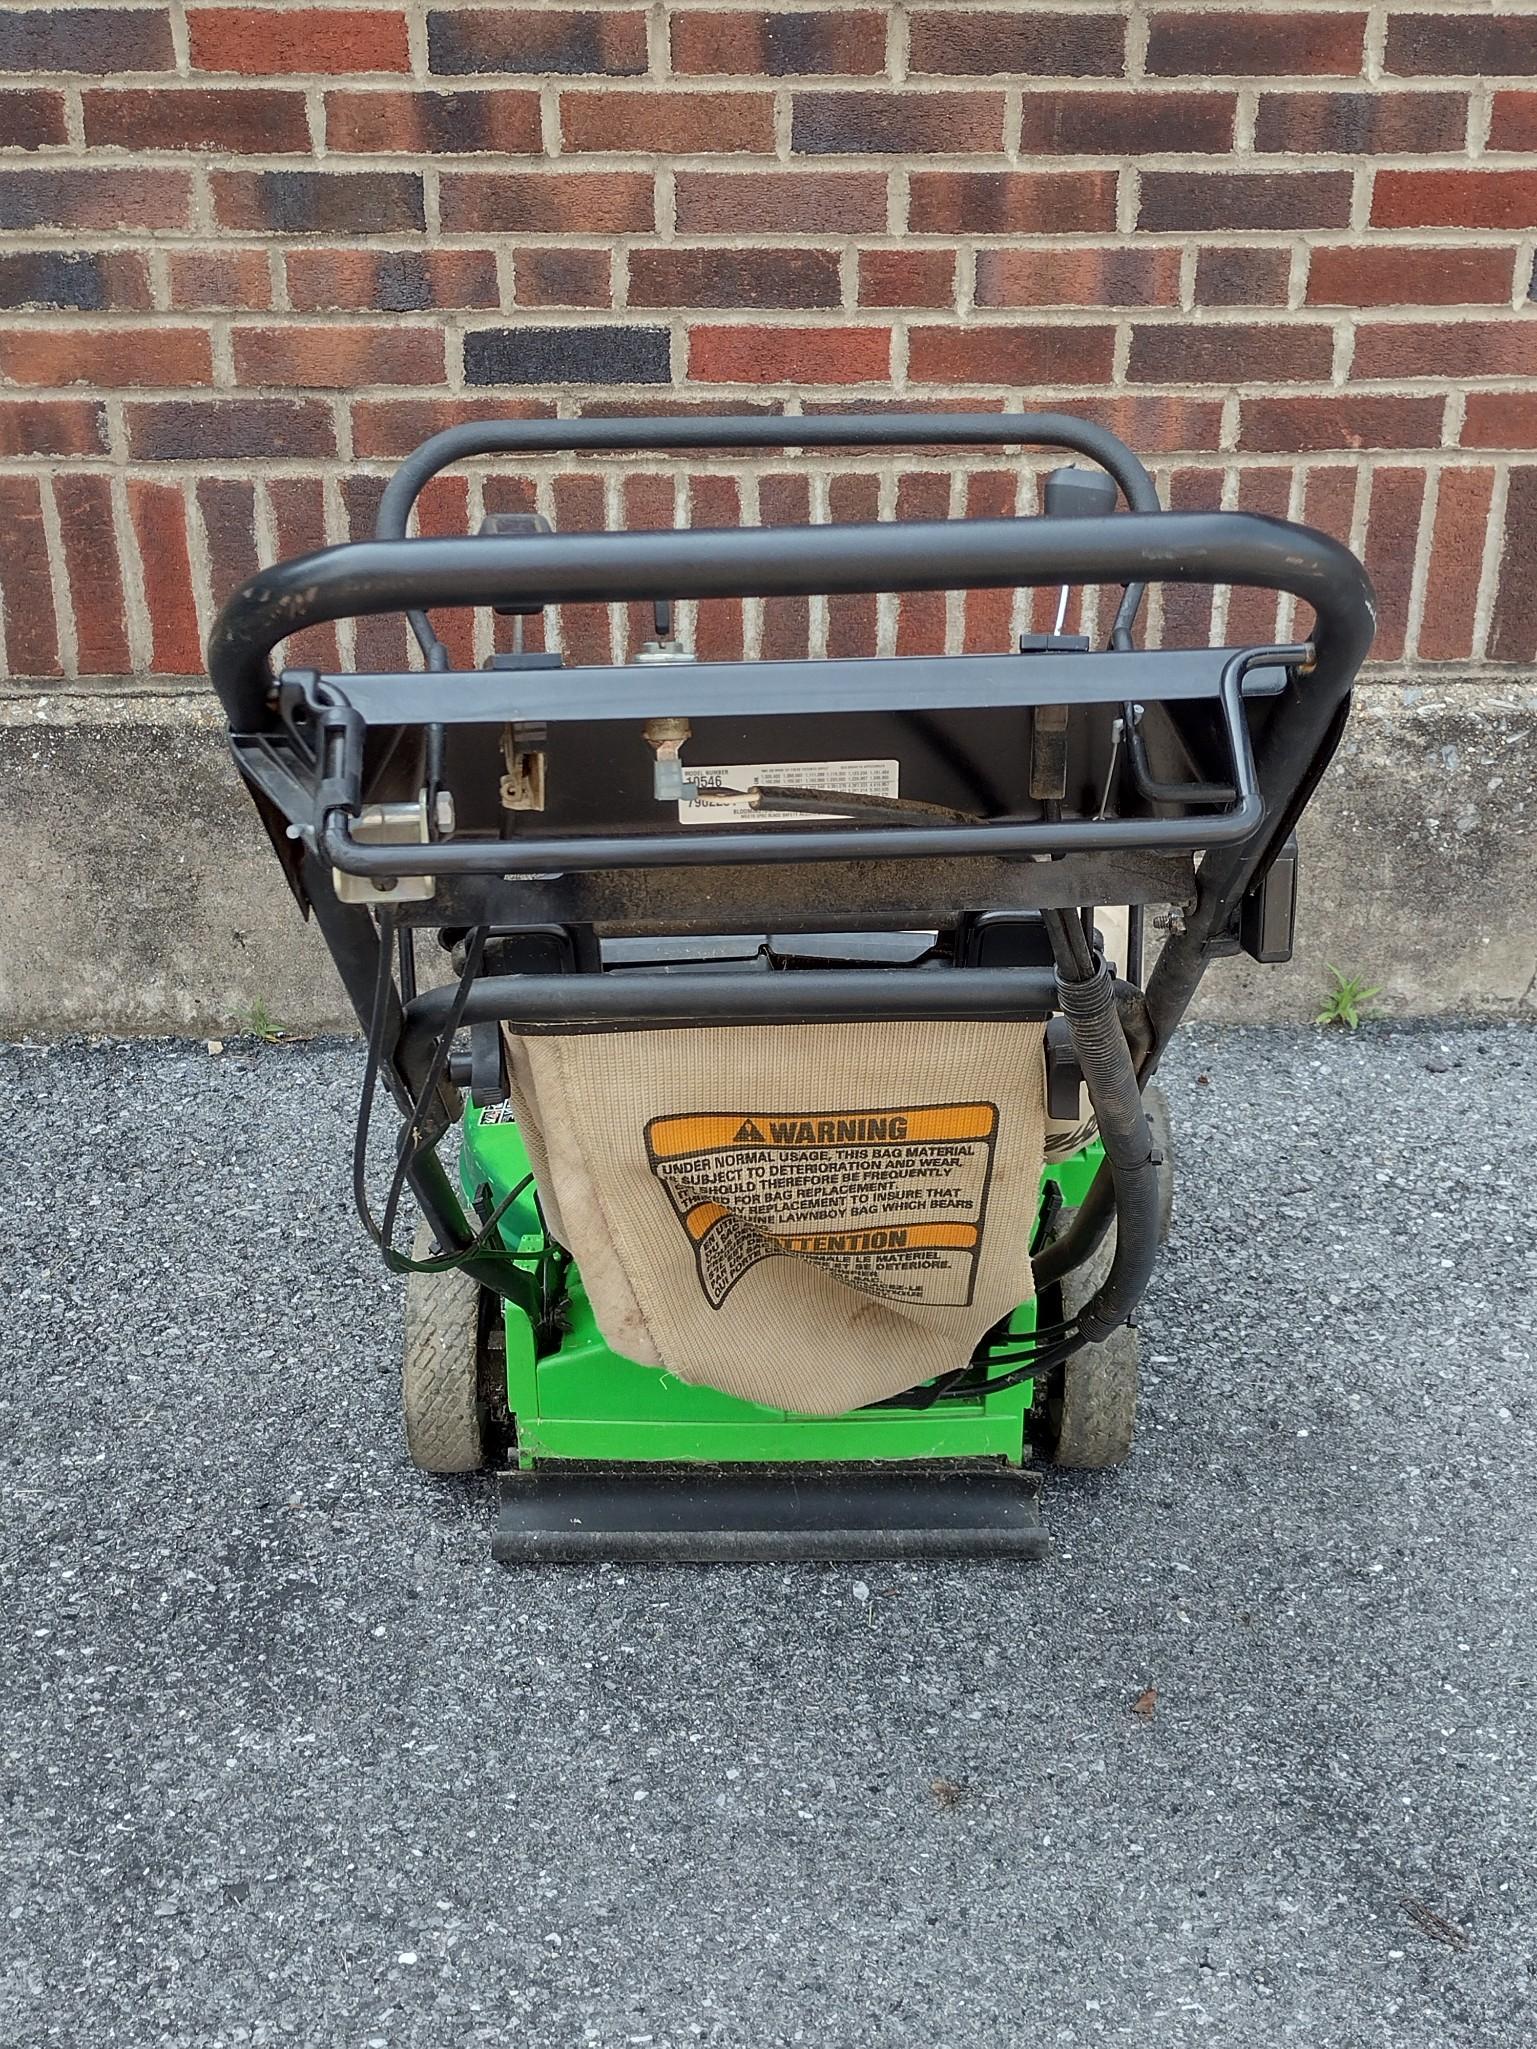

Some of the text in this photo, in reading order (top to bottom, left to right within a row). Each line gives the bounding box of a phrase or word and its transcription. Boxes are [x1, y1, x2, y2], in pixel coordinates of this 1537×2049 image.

[770, 1116, 908, 1143] WARNING
[662, 1146, 975, 1175] UNDER NORMAL USAGE, THIS BAG MATERIAL
[682, 1169, 743, 1185] SUBJECT
[747, 1166, 765, 1178] TO
[769, 1161, 881, 1175] DETERIORATION
[885, 1159, 915, 1169] AND
[919, 1157, 963, 1168] WEAR,
[701, 1182, 756, 1195] SHOULD
[760, 1174, 839, 1190] THEREFORE
[842, 1172, 860, 1183] BE
[863, 1168, 952, 1181] FREQUENTLY
[734, 1194, 760, 1205] FOR
[765, 1190, 792, 1202] BAG
[797, 1181, 898, 1198] REPLACEMENT.
[750, 1197, 848, 1214] REPLACEMENT
[850, 1194, 869, 1205] TO
[873, 1189, 922, 1201] INSURE
[926, 1188, 961, 1198] THAT
[779, 1209, 847, 1223] LAWNBOY
[851, 1204, 878, 1216] BAG
[882, 1200, 926, 1213] WHICH
[930, 1199, 974, 1209] BEARS
[705, 1243, 719, 1258] DU
[721, 1223, 740, 1244] SAC
[834, 1261, 849, 1270] ET
[876, 1259, 952, 1271] DETERIORE.
[856, 1255, 871, 1264] LE
[876, 1251, 941, 1264] MATERIEL
[714, 1277, 729, 1298] QUI
[729, 1249, 761, 1278] PORTE
